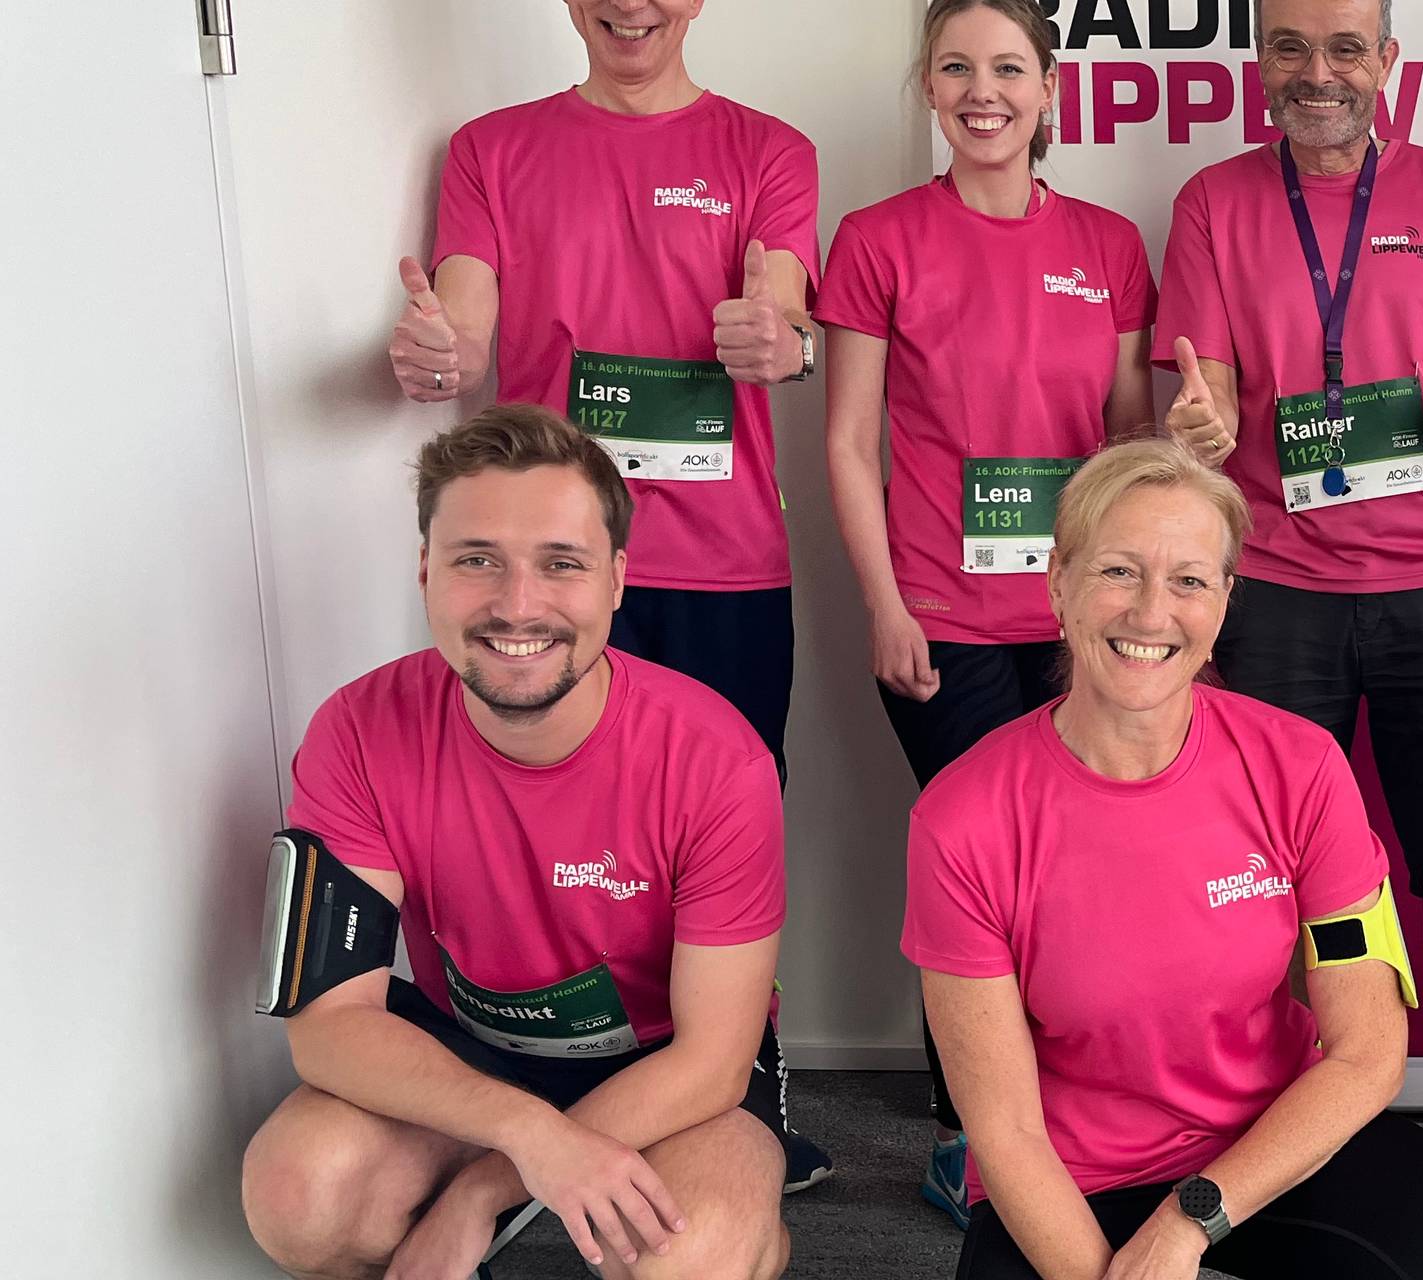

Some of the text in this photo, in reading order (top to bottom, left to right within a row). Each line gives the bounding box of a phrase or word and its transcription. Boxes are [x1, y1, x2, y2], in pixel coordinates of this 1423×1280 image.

[1045, 0, 1250, 50] ADI
[654, 187, 696, 198] RADIO
[653, 196, 732, 214] LIPPEWELLE
[1370, 235, 1410, 246] RADIO
[1043, 273, 1077, 287] RADIO
[1044, 283, 1110, 299] LIPPEWELLE
[599, 362, 692, 379] AOK-Firmenlauf
[578, 377, 632, 403] Lars
[1279, 386, 1414, 416] 16. AOK-enlauf Hamm
[577, 407, 628, 429] 1127
[705, 425, 725, 433] LAUF
[1401, 438, 1420, 448] LAUF
[681, 454, 710, 466] AOK
[1286, 443, 1334, 467] 1125
[975, 466, 992, 476] 16.
[994, 466, 1072, 477] AOK-Firmenlauf
[1386, 467, 1411, 482] AOK
[974, 483, 1032, 503] Lena
[975, 509, 1023, 528] 1131
[553, 862, 605, 876] RADIO
[552, 873, 650, 894] LIPPEWELLE
[1206, 870, 1254, 895] RADIO
[1208, 876, 1292, 908] LIPPEWELL
[1263, 888, 1289, 900] HAMM
[445, 966, 557, 1020] Benedikt
[553, 978, 599, 1000] Hamm
[585, 1016, 612, 1029] LAUF
[566, 1041, 602, 1051] AOK
